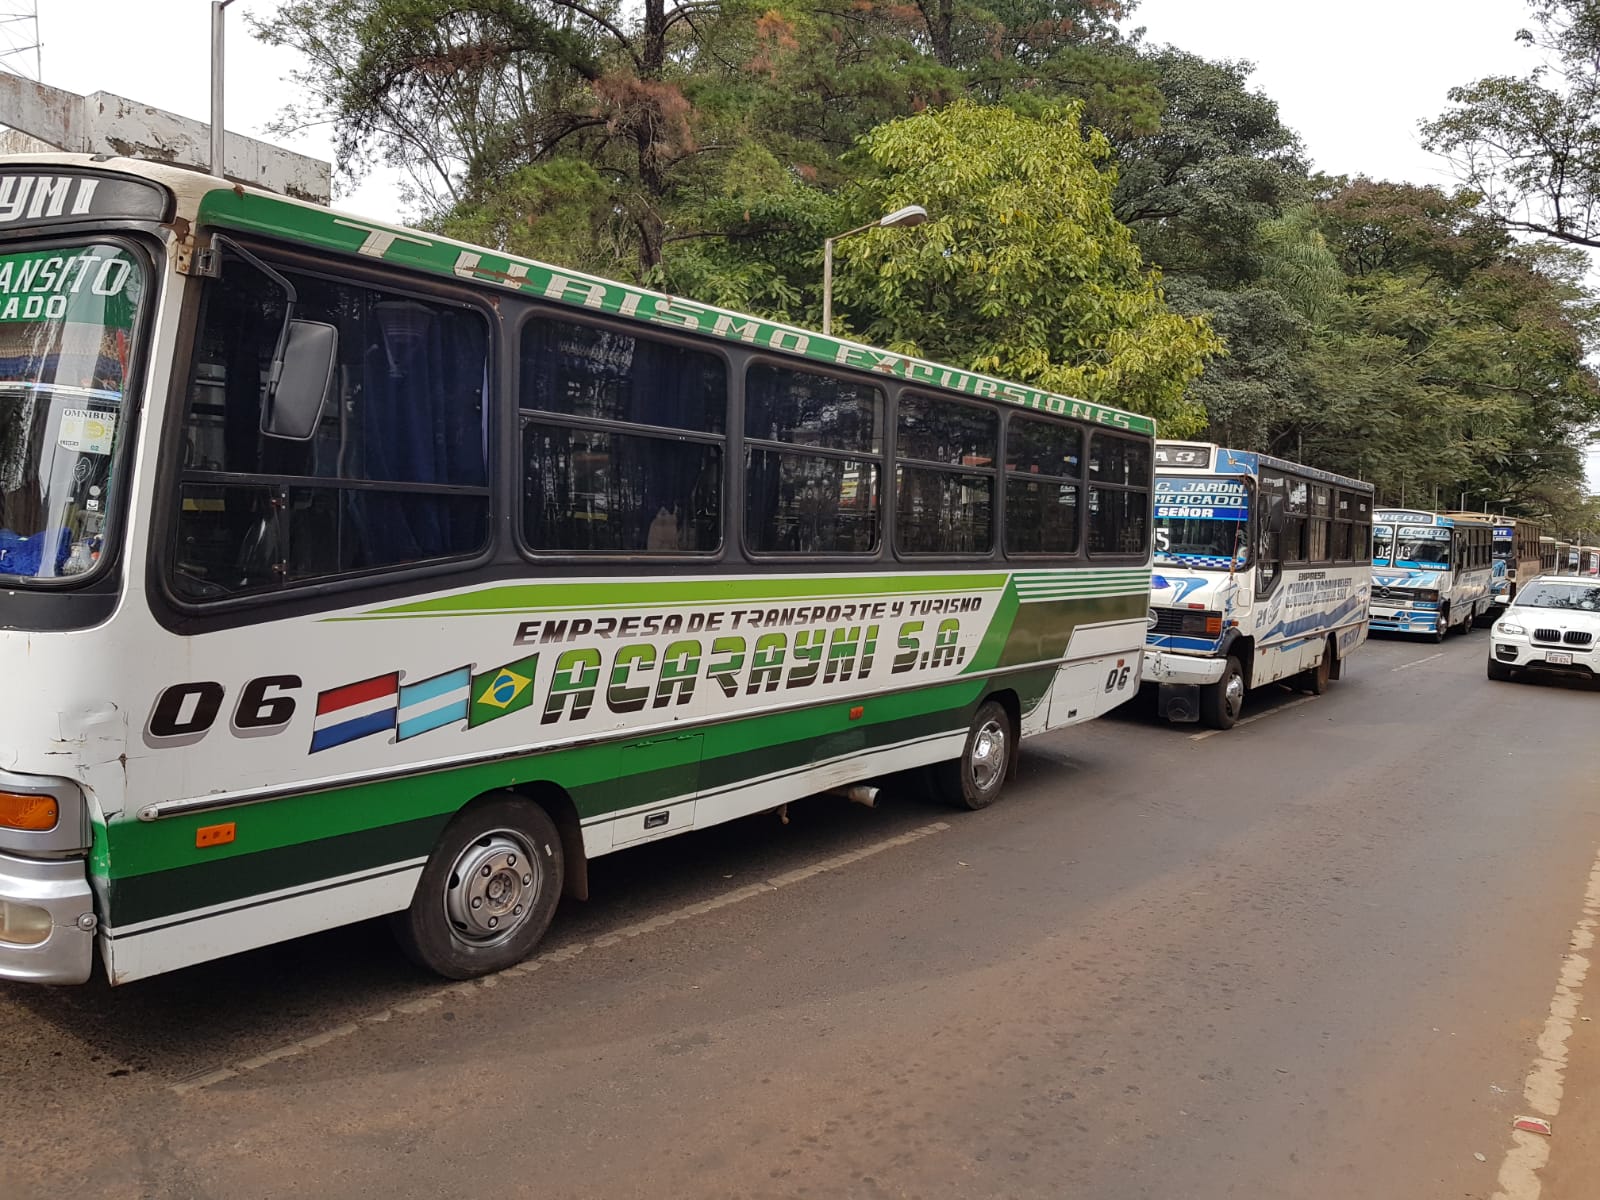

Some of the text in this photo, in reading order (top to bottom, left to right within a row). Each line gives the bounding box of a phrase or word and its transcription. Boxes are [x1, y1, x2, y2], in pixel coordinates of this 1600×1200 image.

[333, 218, 1141, 430] TURISMO EXCURSIONES
[64, 409, 115, 421] OMNIBUS
[1175, 451, 1196, 462] 3
[1182, 482, 1245, 494] JARDIN
[1155, 494, 1243, 506] MERCADO
[1158, 505, 1214, 518] SEÑOR
[513, 614, 684, 647] EMPRESA
[687, 612, 725, 633] DE
[729, 602, 887, 631] TRANSPORTE
[910, 597, 983, 617] TURISMO
[540, 617, 966, 725] ACARAYMI S.A.
[1104, 666, 1131, 693] 06
[143, 674, 302, 748] 06
